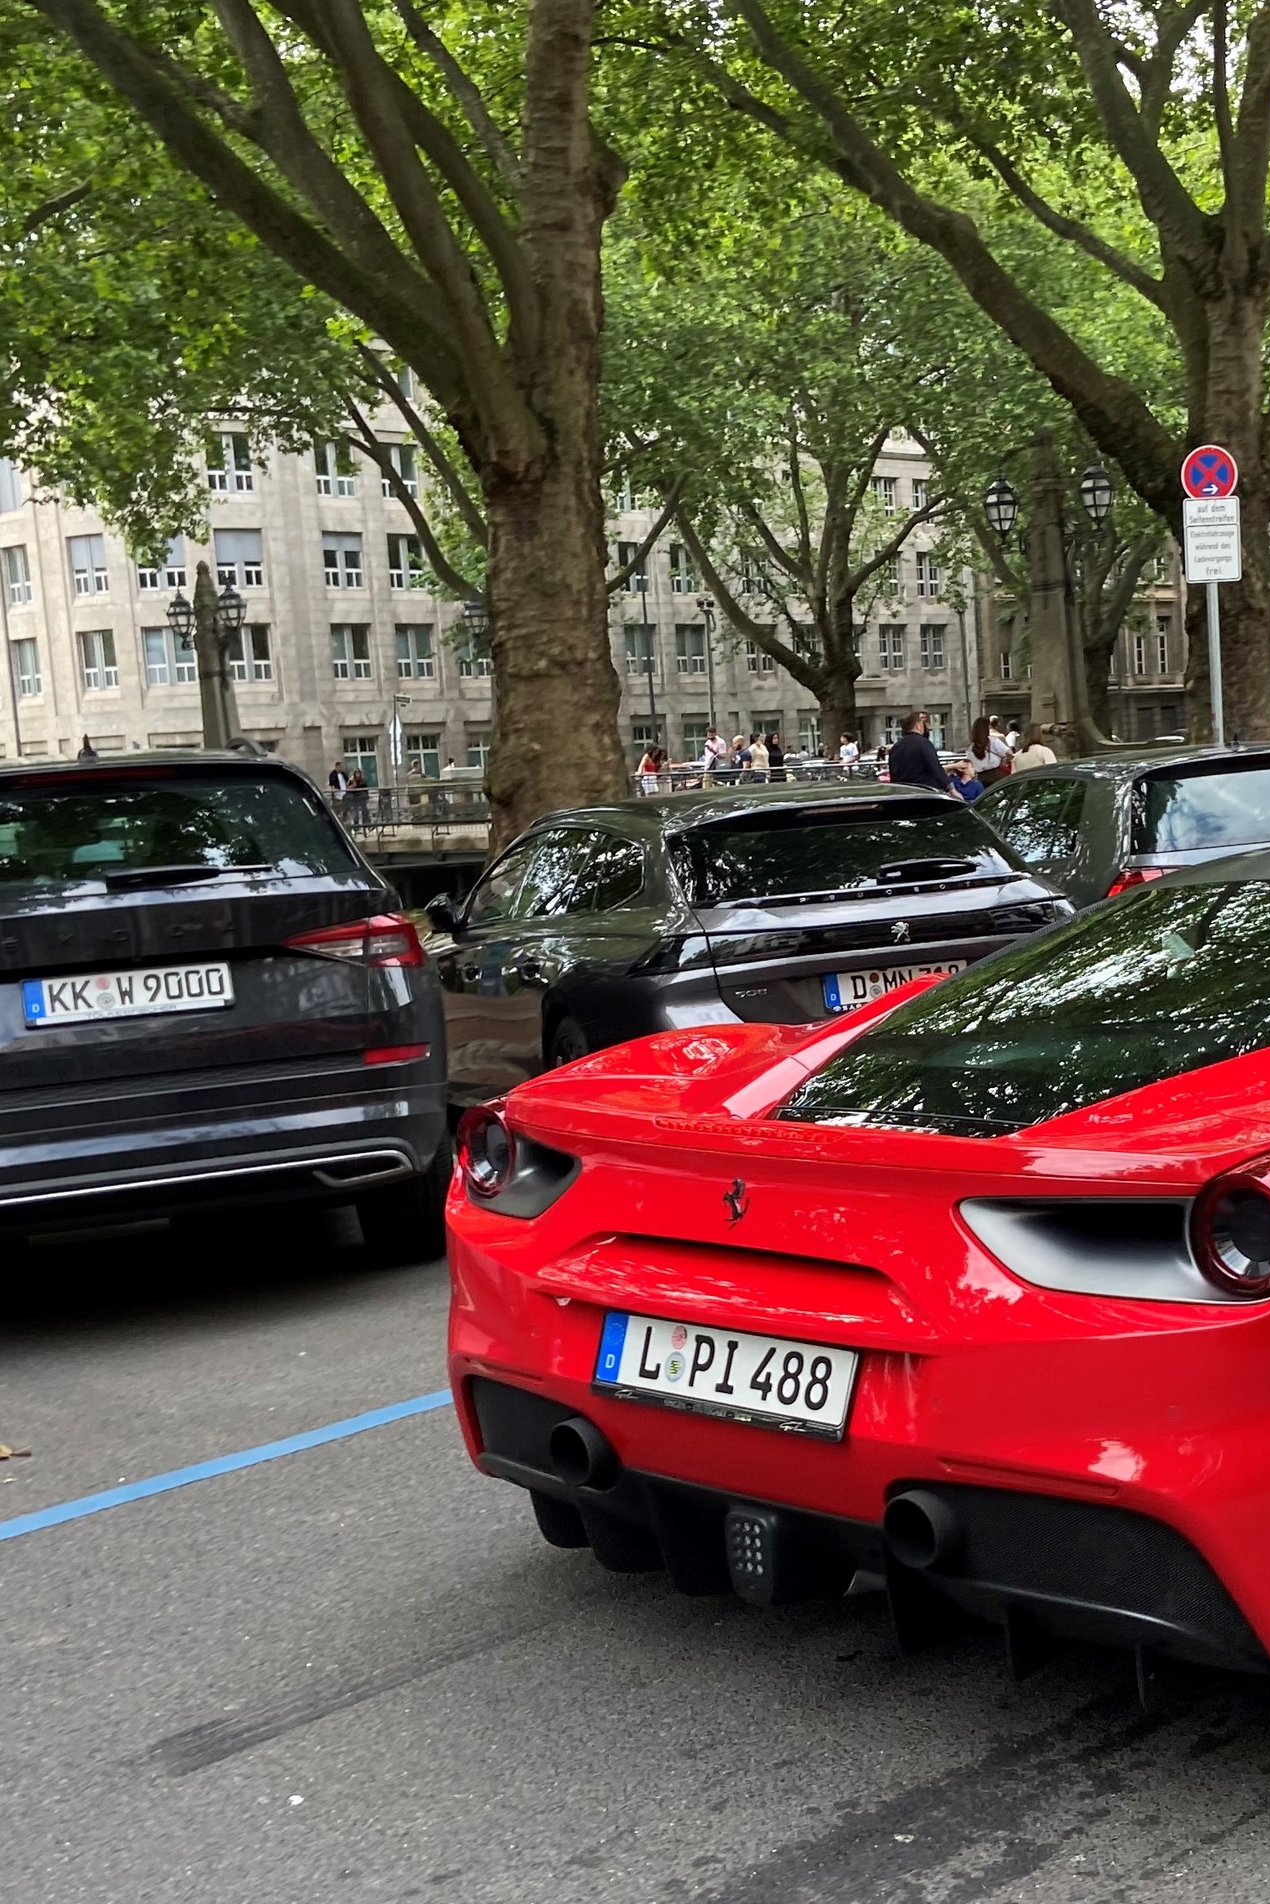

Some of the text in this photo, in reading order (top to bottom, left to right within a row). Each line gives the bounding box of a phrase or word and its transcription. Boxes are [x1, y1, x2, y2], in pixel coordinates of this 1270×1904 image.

[1197, 504, 1226, 513] auf dem
[1189, 515, 1235, 524] Seitenstreifen
[1206, 567, 1222, 575] frei
[800, 881, 971, 904] PEUGEOT
[48, 968, 225, 1013] KK W 9000
[850, 974, 867, 1000] D
[32, 1004, 40, 1013] D
[604, 1354, 615, 1369] D
[639, 1325, 832, 1411] L PI 488
